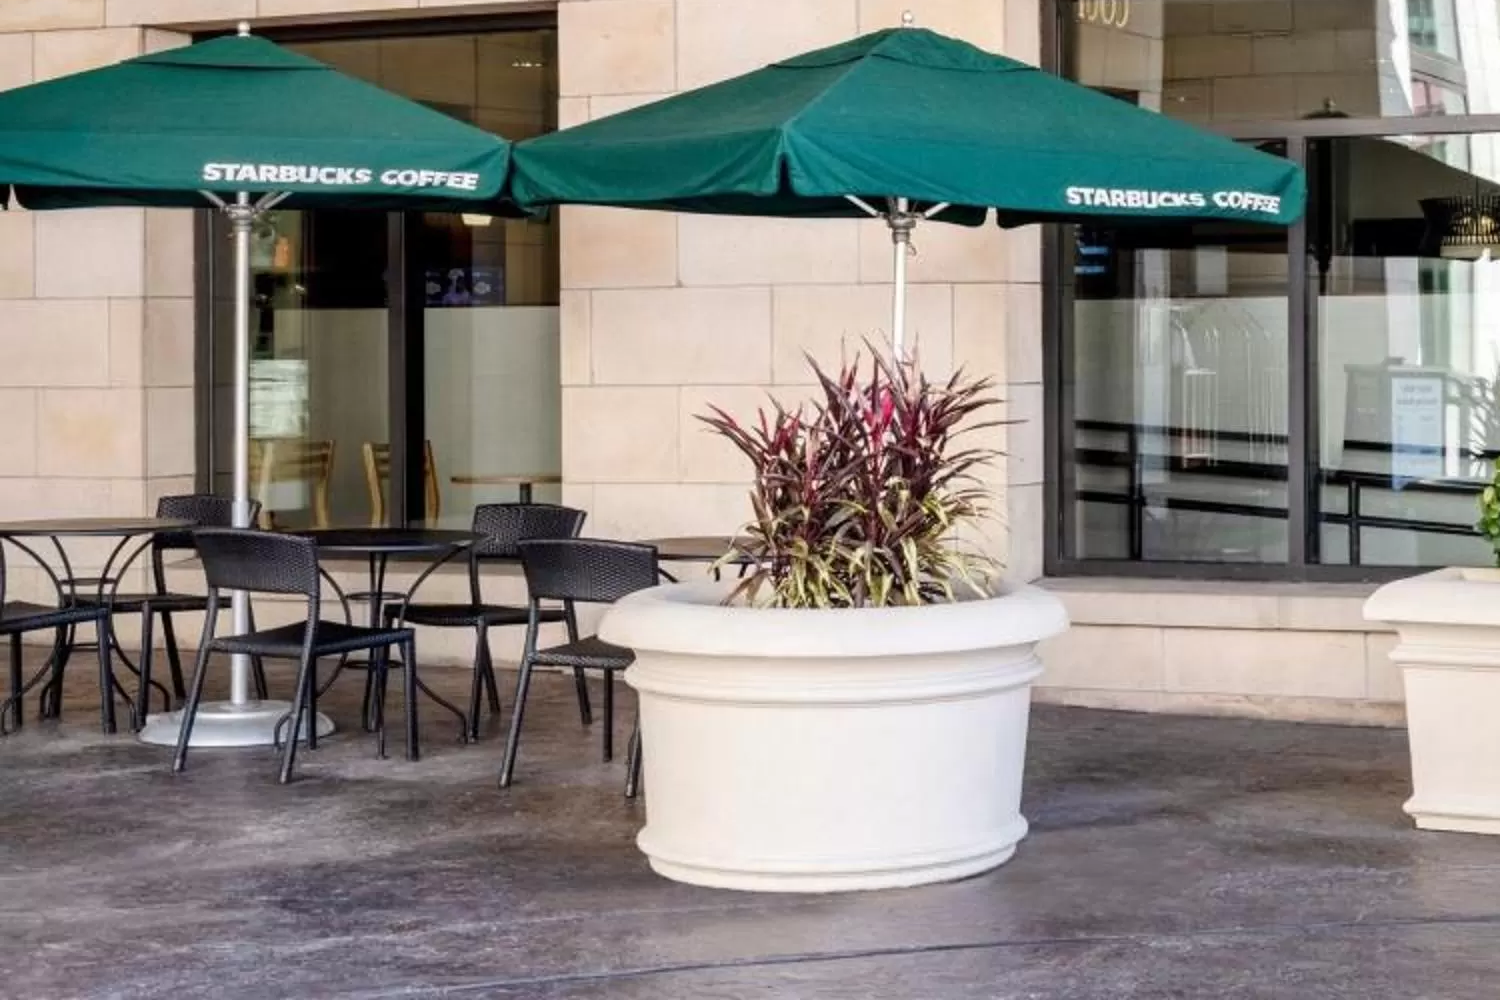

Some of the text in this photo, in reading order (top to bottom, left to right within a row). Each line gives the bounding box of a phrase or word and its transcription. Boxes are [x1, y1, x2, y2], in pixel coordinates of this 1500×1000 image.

[202, 162, 479, 191] STARBUCKS COFFEE
[1066, 186, 1281, 214] STARBUCKS COFFEE
